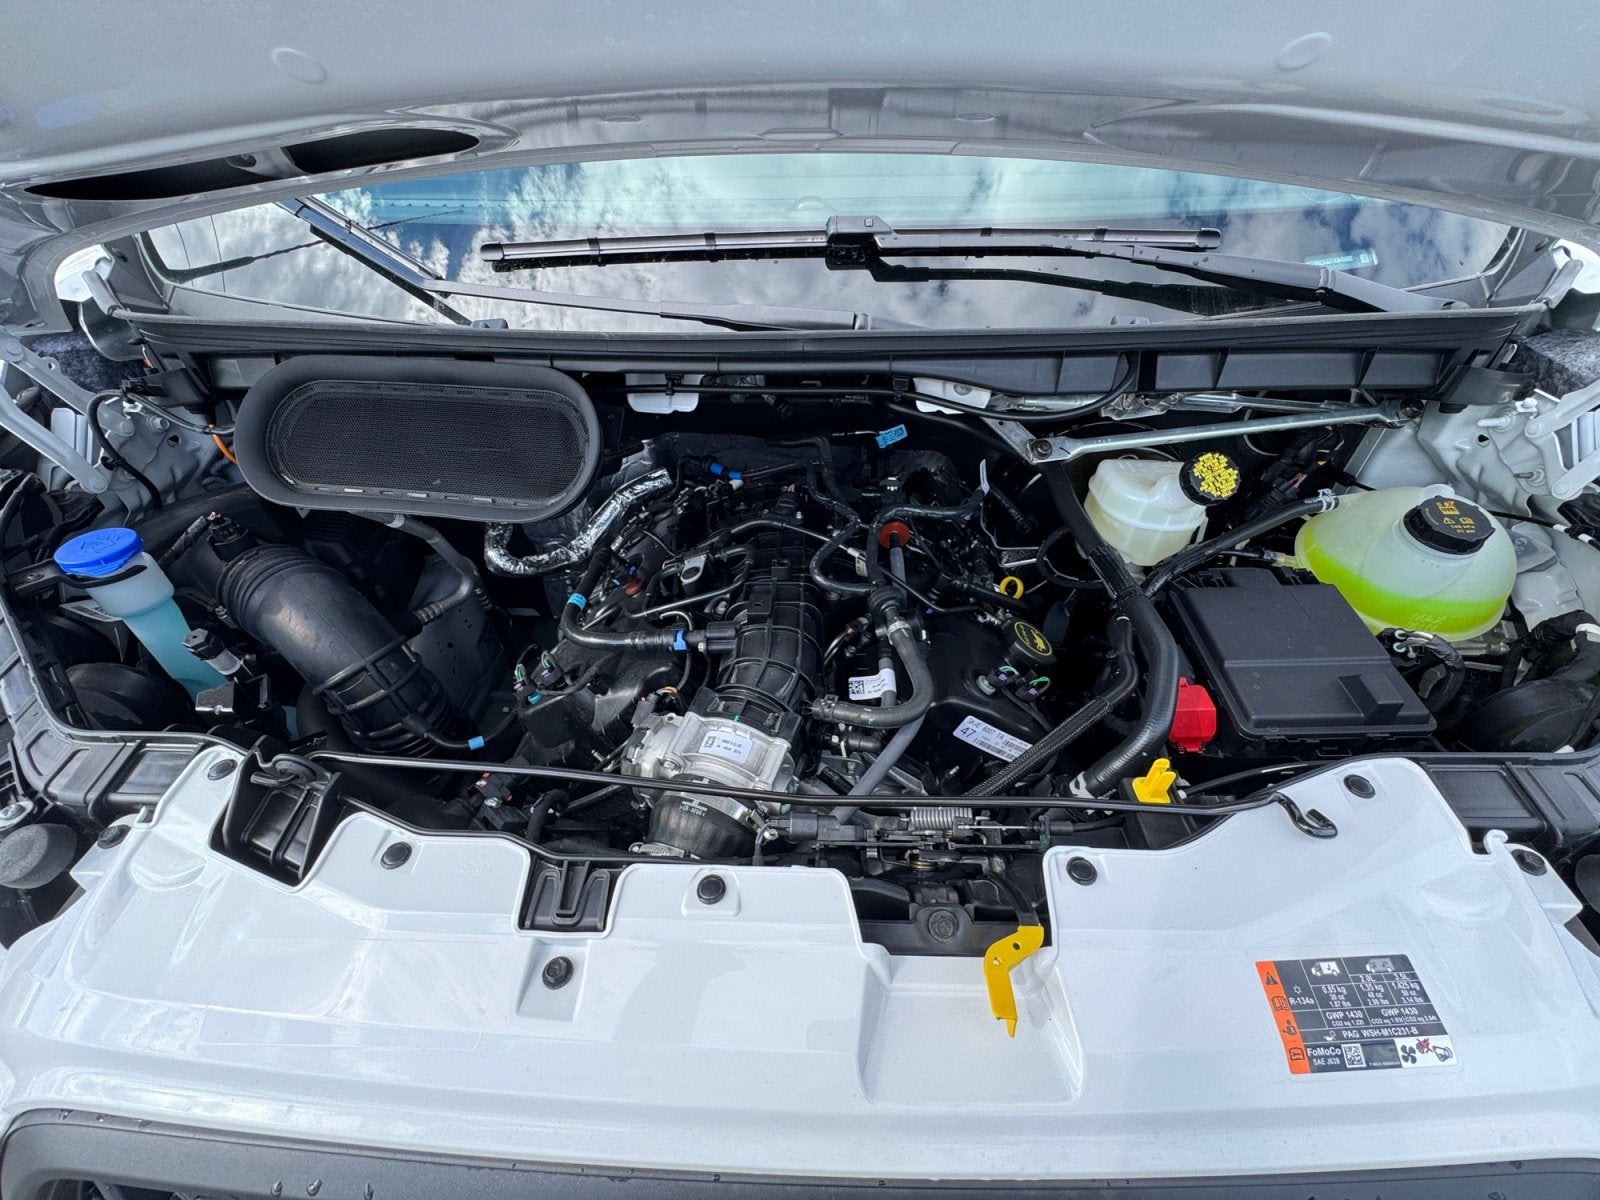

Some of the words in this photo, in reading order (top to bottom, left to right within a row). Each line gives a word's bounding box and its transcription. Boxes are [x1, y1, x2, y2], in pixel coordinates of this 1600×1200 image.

[960, 727, 977, 738] 47
[1338, 985, 1347, 995] kg
[1360, 982, 1376, 991] 1.35
[1375, 982, 1384, 993] kg
[1410, 981, 1420, 991] kg
[1289, 997, 1316, 1006] R-134a
[1326, 1011, 1344, 1020] GWP
[1345, 1010, 1364, 1019] 1430
[1381, 1008, 1399, 1017] GWP
[1400, 1007, 1419, 1016] 1430
[1342, 1030, 1360, 1039] PAG
[1361, 1026, 1419, 1038] WSH-M1C231-B
[1307, 1047, 1341, 1057] FoMoCo
